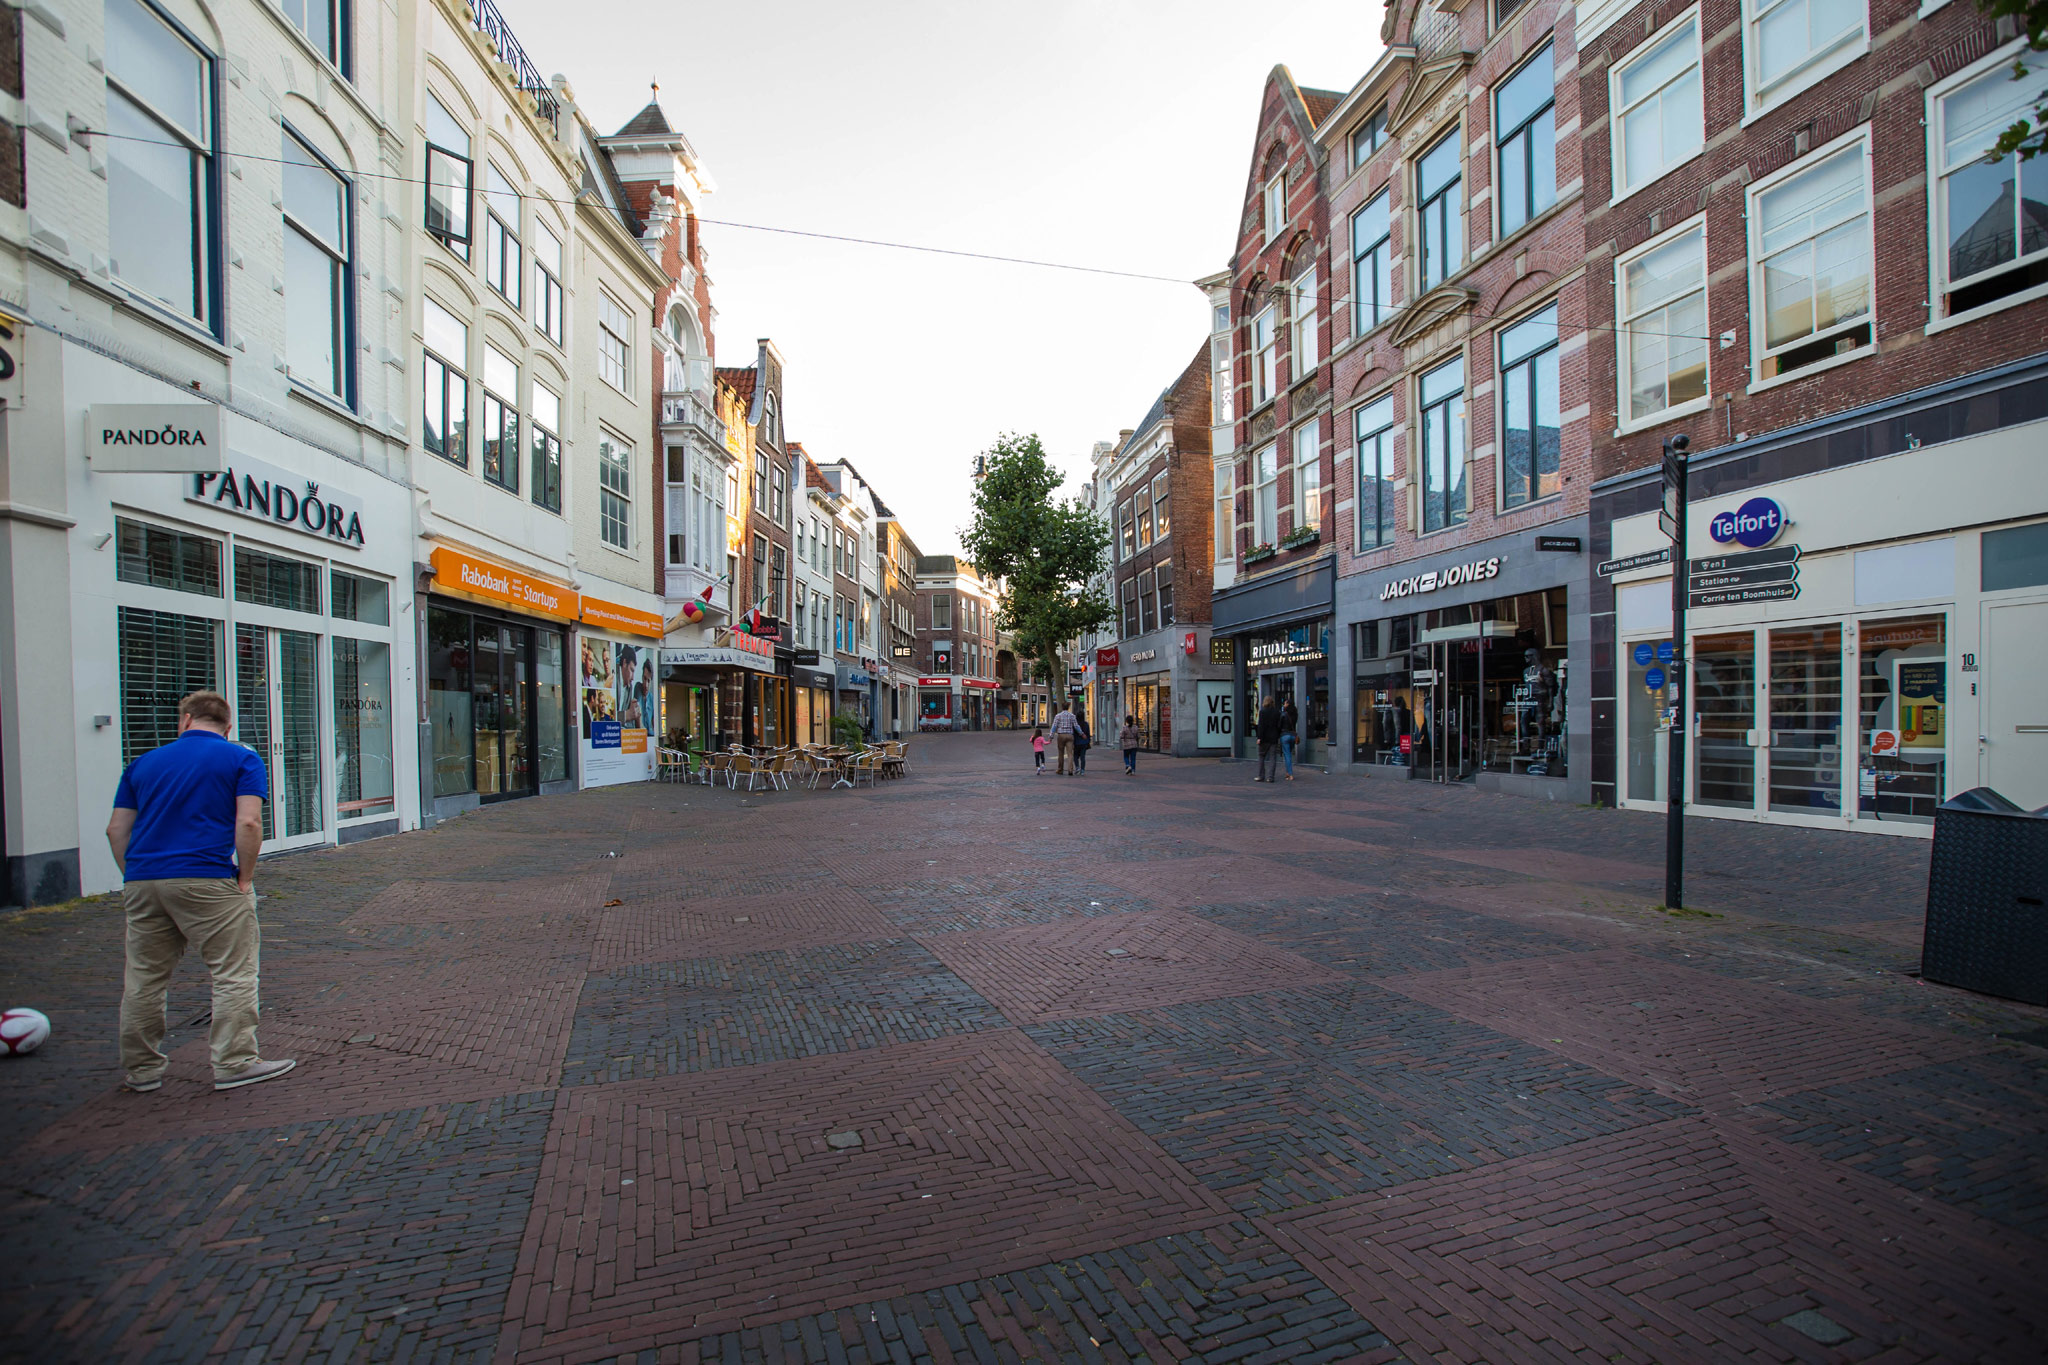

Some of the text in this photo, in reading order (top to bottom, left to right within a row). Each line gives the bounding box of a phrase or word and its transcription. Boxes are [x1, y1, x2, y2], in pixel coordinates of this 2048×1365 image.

[103, 425, 207, 446] PANDORA
[194, 467, 366, 545] PANDORA
[1712, 509, 1779, 538] Telfort
[1603, 554, 1660, 572] Frans Hals Museum
[461, 563, 509, 595] Rabobank
[523, 585, 558, 612] Startups
[1380, 557, 1500, 601] JACK JONES
[1700, 576, 1729, 586] Station
[1701, 588, 1785, 604] Corrie ten Boomhuis
[734, 630, 774, 658] TREMONTI
[894, 647, 911, 656] WE
[1271, 655, 1286, 665] body
[1288, 651, 1322, 662] cosmetics
[1961, 653, 1975, 666] 10
[340, 698, 382, 710] PANDORA
